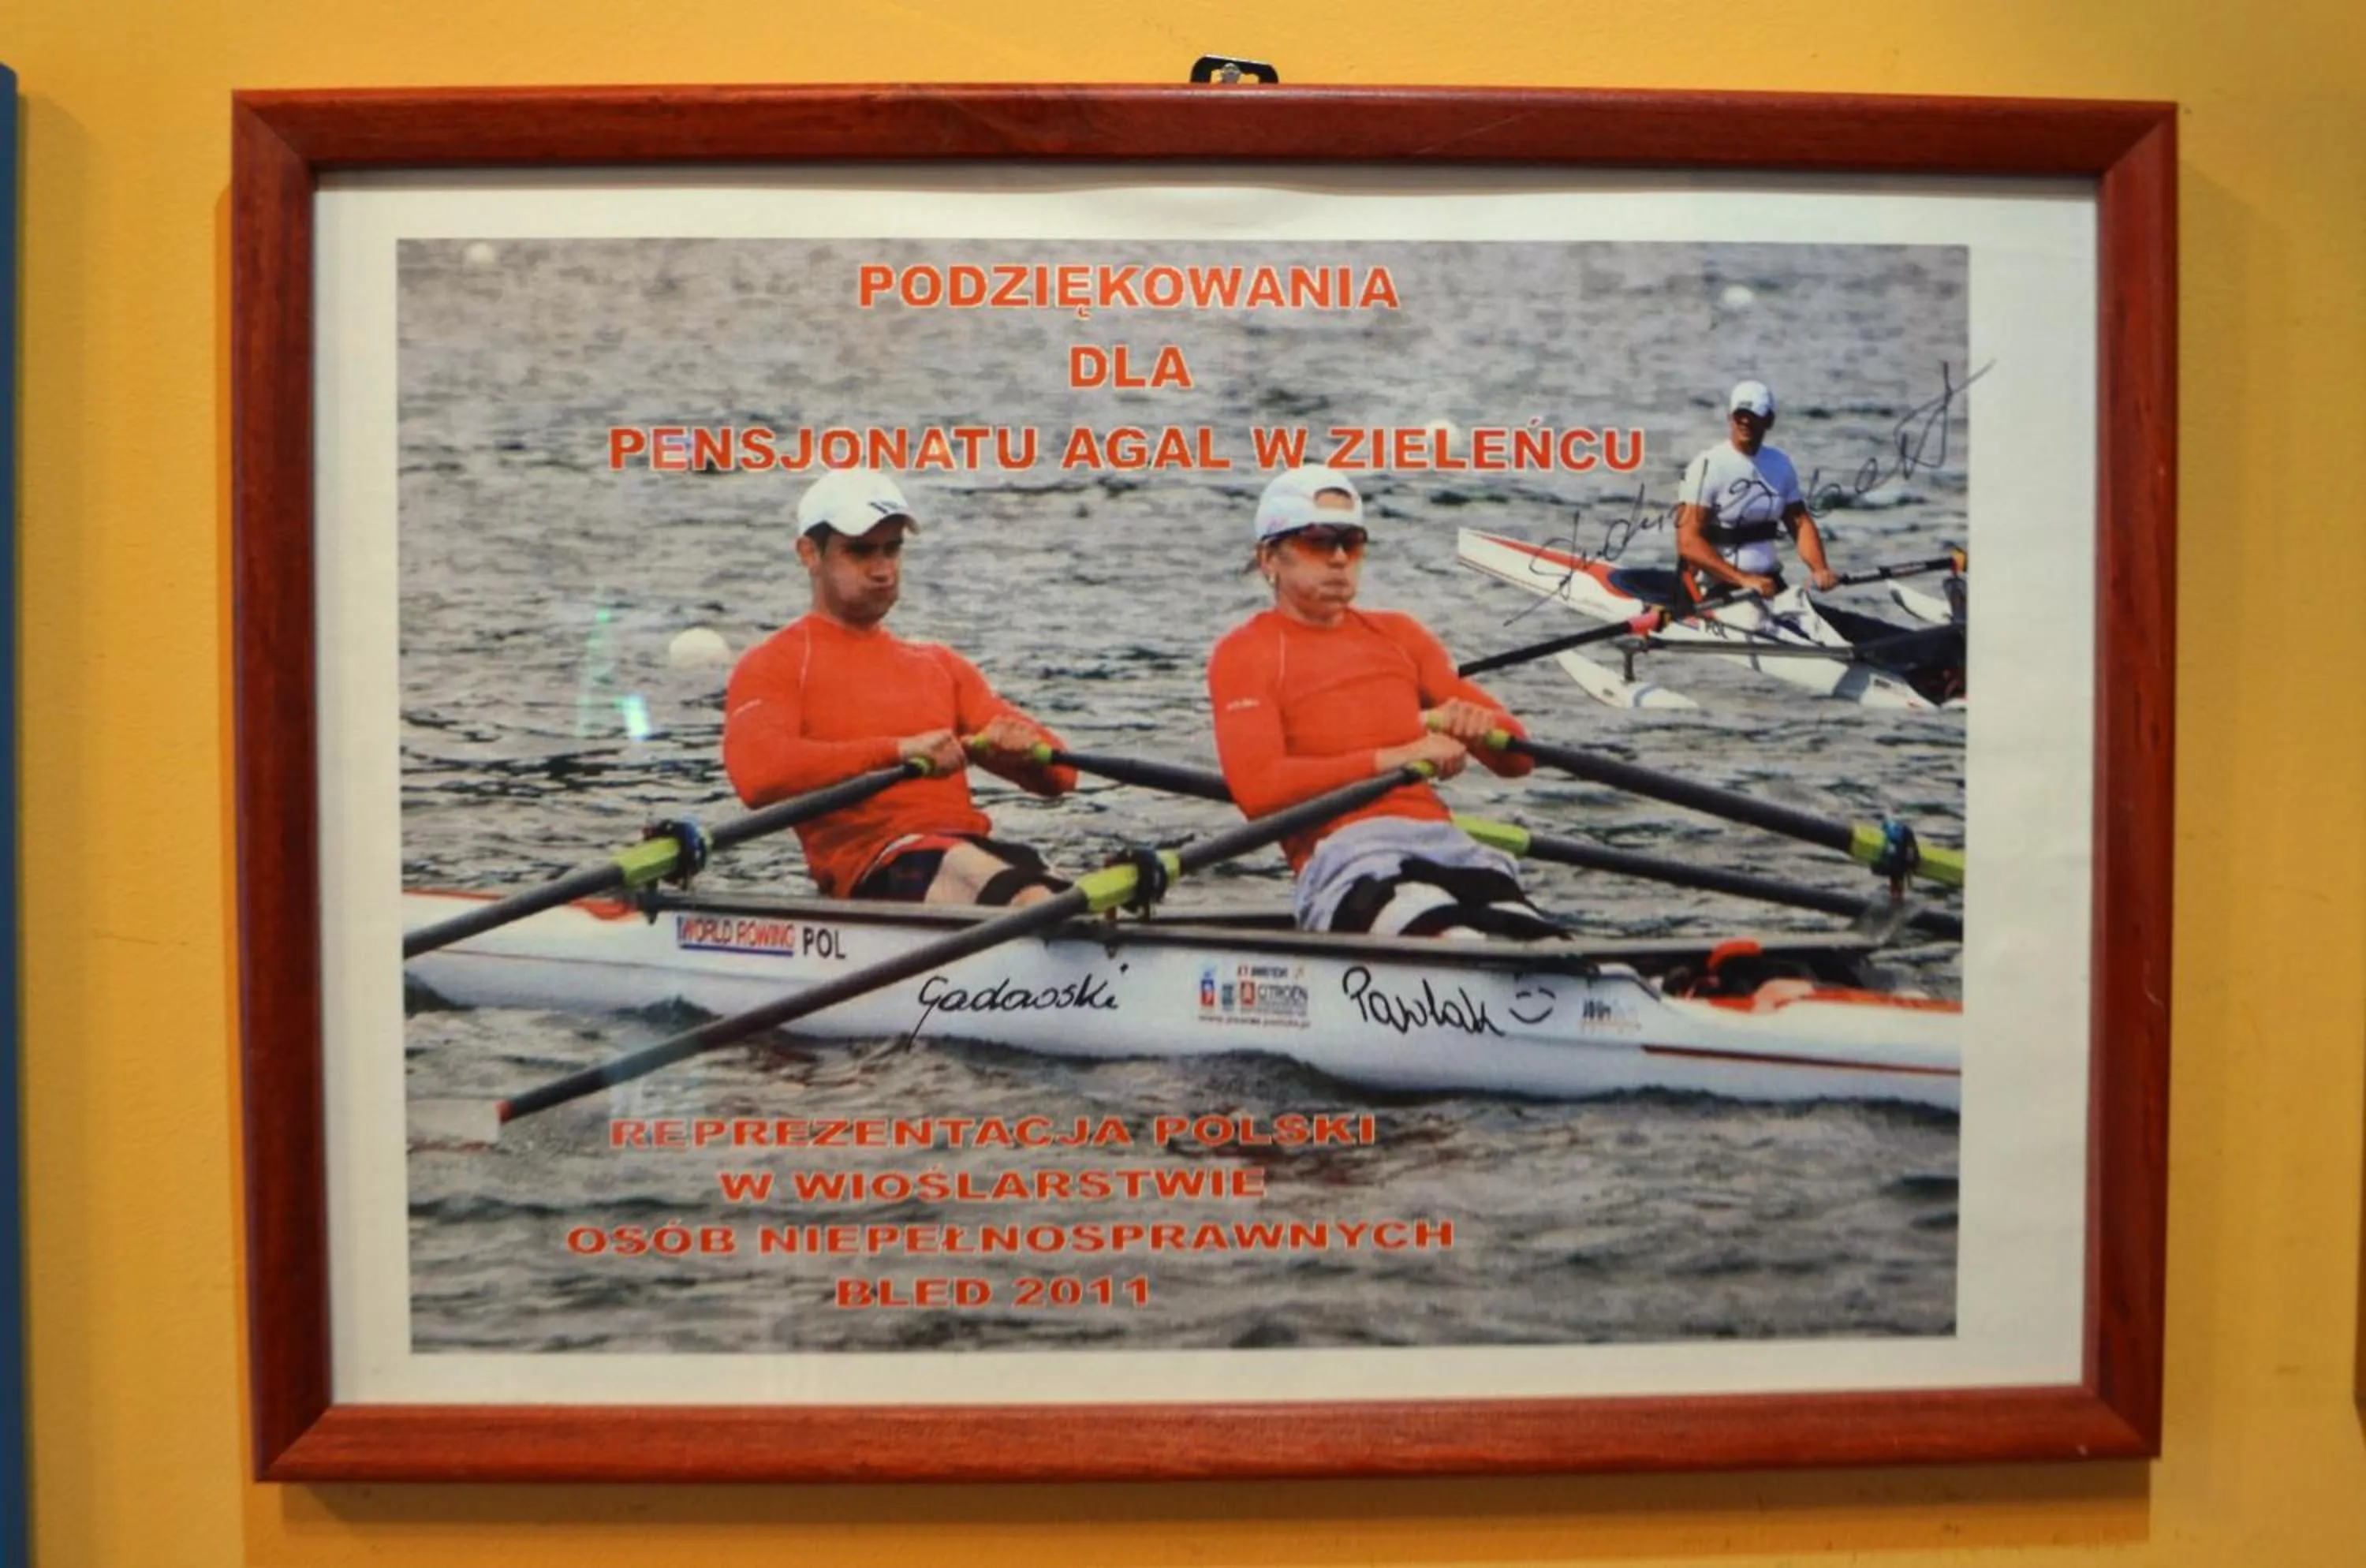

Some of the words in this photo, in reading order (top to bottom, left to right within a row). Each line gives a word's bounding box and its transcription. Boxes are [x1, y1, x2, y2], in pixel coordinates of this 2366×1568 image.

[859, 264, 1400, 317] PODZIĘKOWANIA
[1069, 344, 1194, 390] DLA
[608, 425, 1039, 472] PENSJONATU
[1060, 426, 1232, 471] AGAL
[1251, 426, 1310, 472] W
[1325, 415, 1645, 473] ZIELEŃCU
[681, 918, 733, 944] WORLD
[736, 921, 796, 948] ROWING
[803, 927, 847, 960] POL
[610, 1117, 1133, 1148] REPREZENTACJA
[1153, 1113, 1379, 1146] POLSKI
[719, 1172, 774, 1200] W
[793, 1165, 1267, 1203] WIOŚLARSTWIE
[566, 1219, 737, 1255] OSÓB
[759, 1219, 1454, 1253] NIEPEŁNOSPRAWNYCH
[834, 1277, 995, 1309] BLED
[1011, 1276, 1151, 1309] 2011
